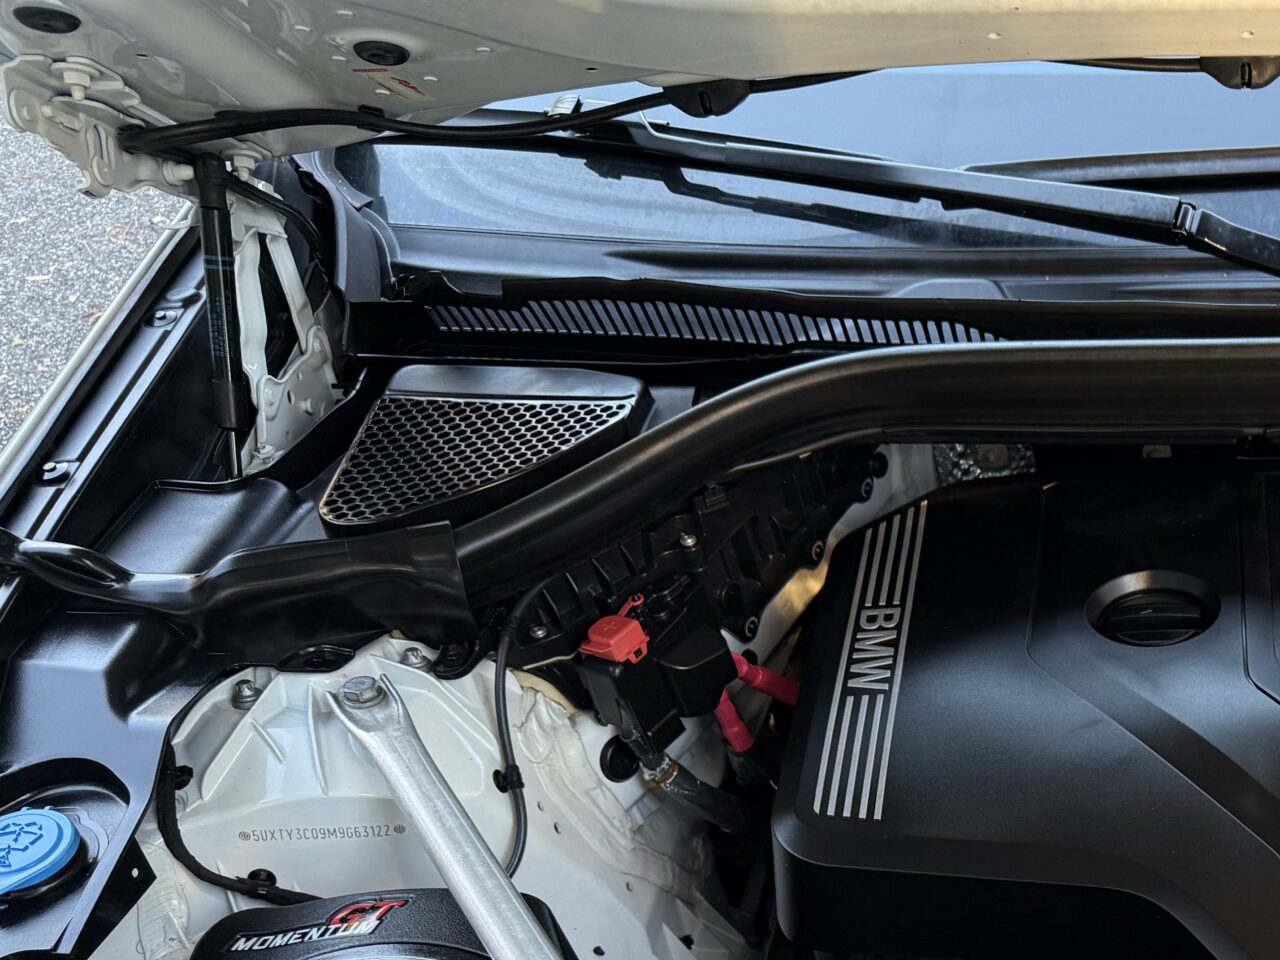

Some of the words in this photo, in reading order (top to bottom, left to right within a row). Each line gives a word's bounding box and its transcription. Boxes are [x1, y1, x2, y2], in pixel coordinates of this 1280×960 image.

[847, 607, 901, 690] BMW
[251, 824, 391, 842] 5UXTY3C09M9G63122
[329, 900, 409, 926] GT
[230, 919, 381, 951] MOMENTUM
